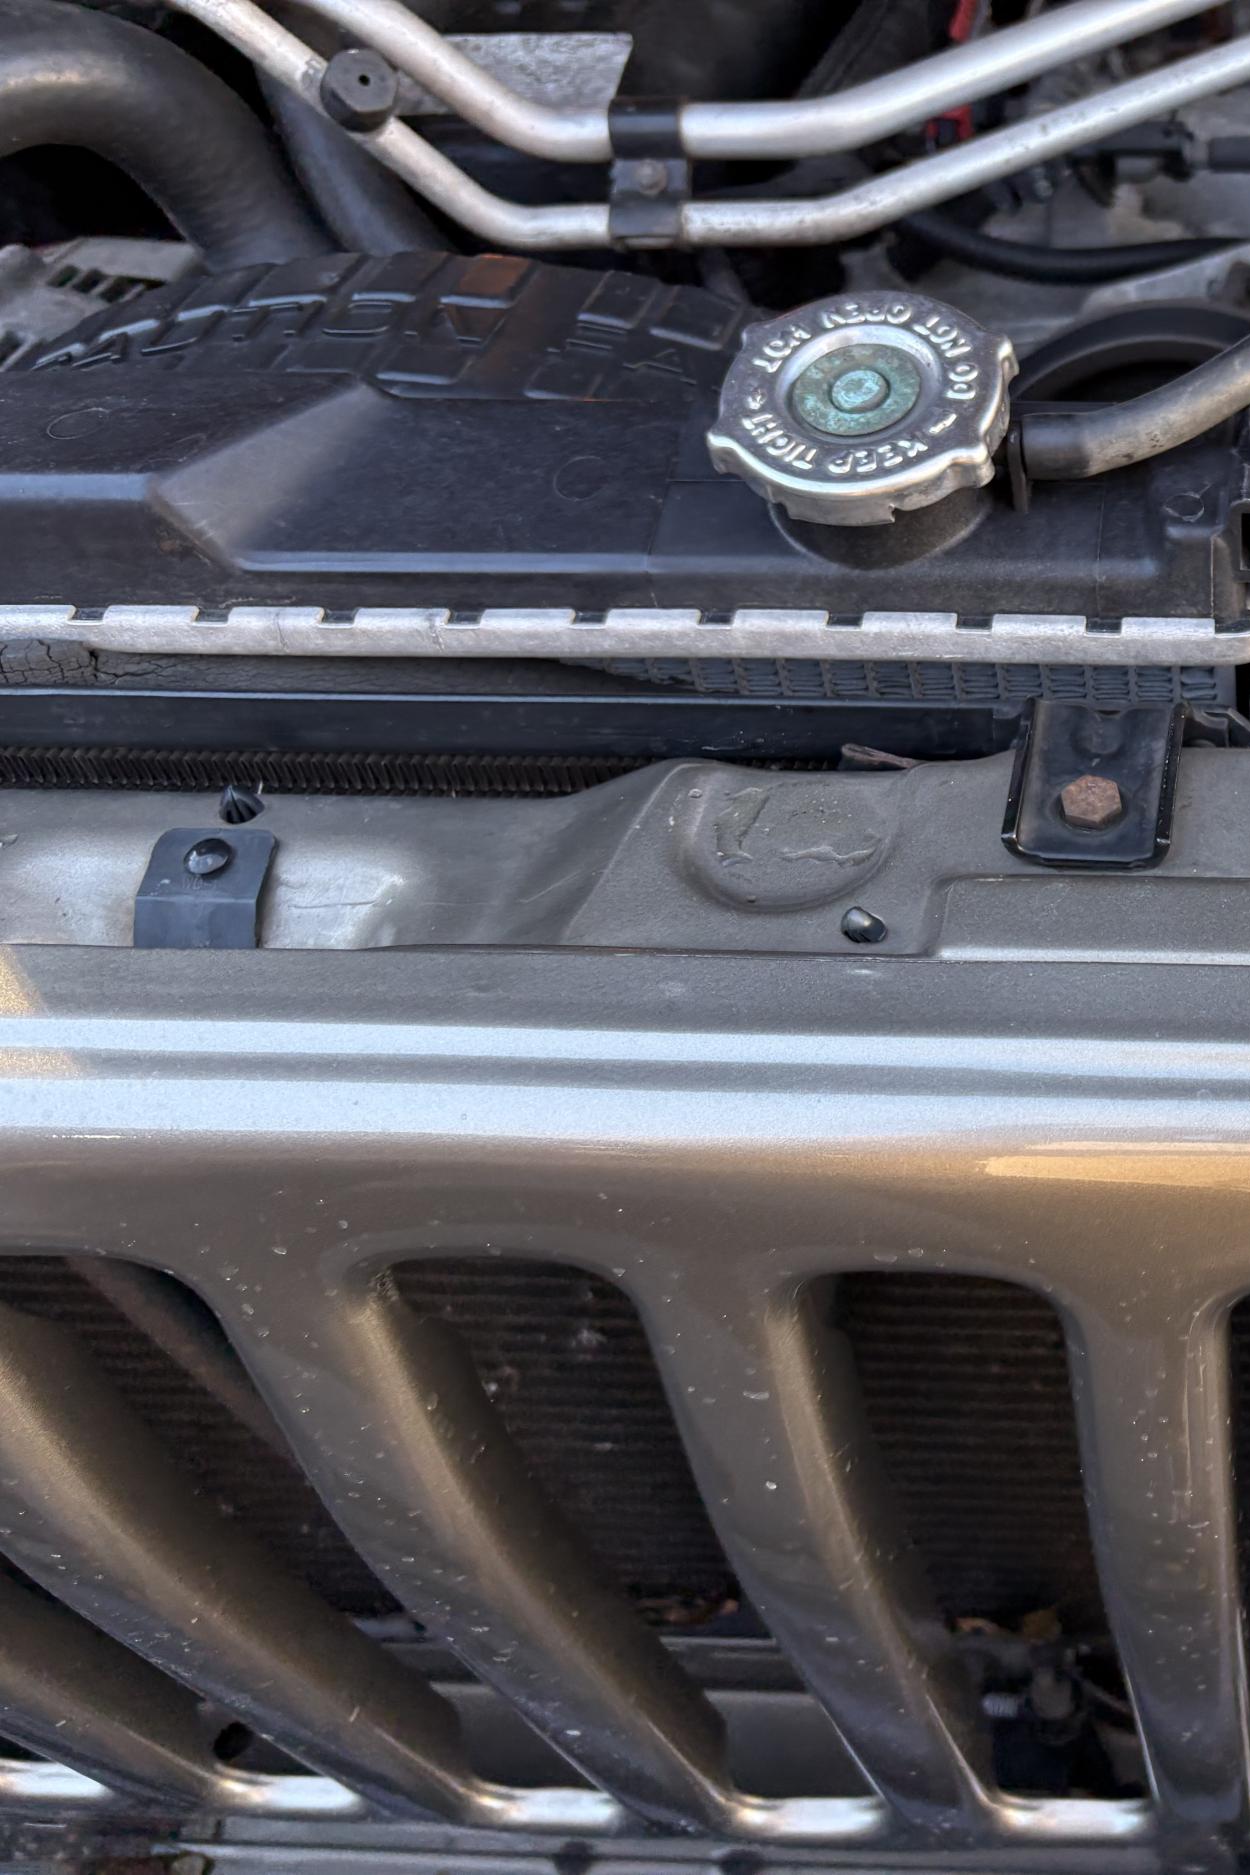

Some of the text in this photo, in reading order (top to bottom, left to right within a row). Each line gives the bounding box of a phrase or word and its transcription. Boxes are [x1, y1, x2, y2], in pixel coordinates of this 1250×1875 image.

[751, 302, 979, 401] DO NOT OPEN HOT
[740, 412, 930, 475] KEEP TIGHT
